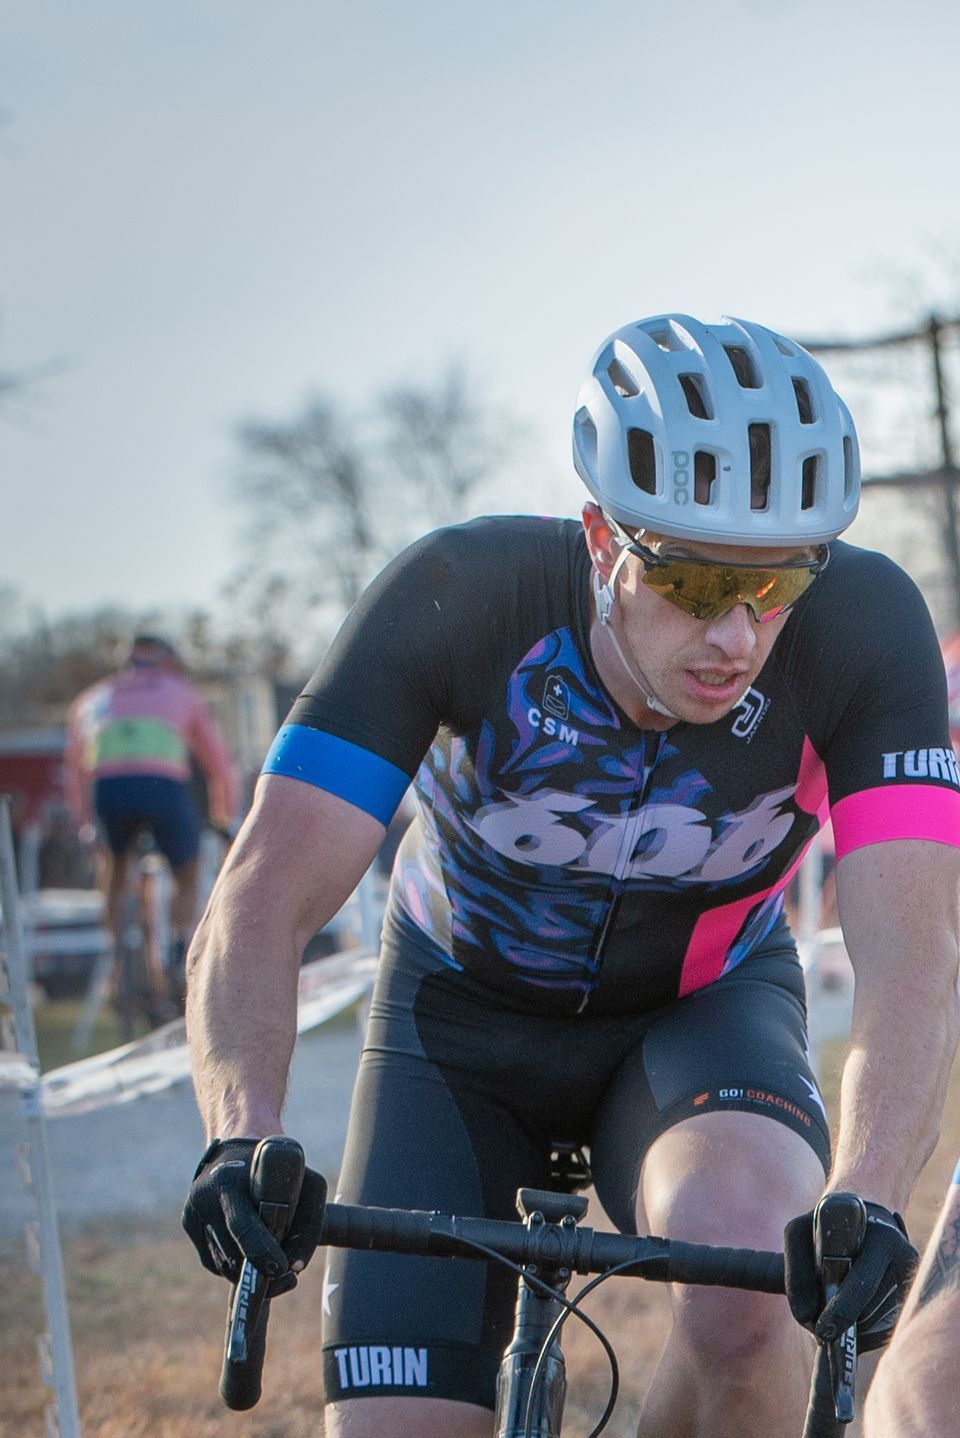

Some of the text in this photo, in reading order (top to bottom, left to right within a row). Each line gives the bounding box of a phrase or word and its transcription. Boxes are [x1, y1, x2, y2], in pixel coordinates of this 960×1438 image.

[527, 707, 579, 747] CSM
[719, 1088, 812, 1127] GO! COACHING
[334, 1346, 428, 1390] TURIN
